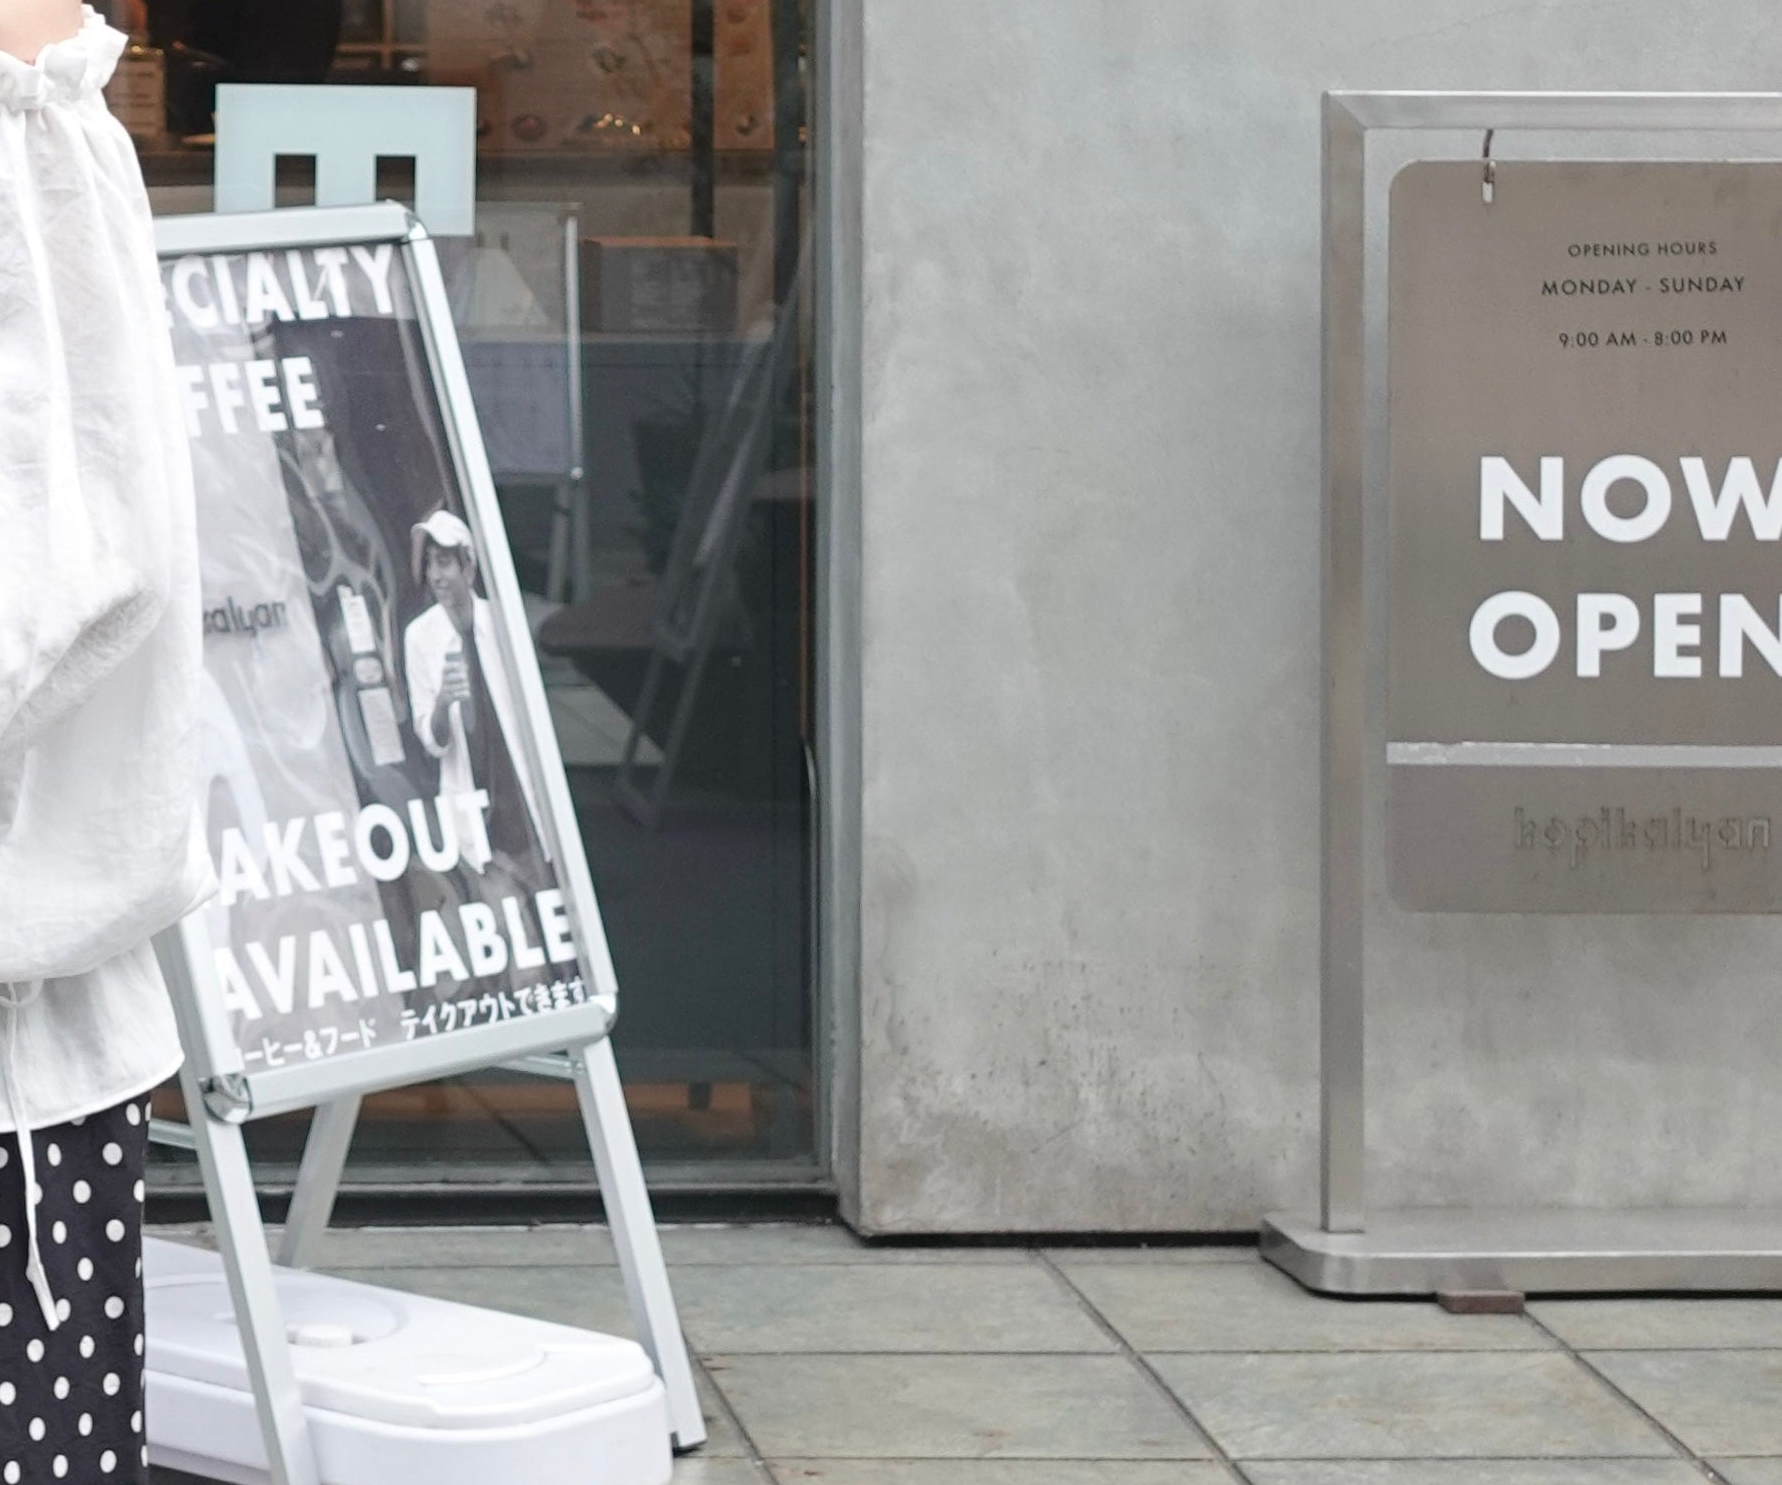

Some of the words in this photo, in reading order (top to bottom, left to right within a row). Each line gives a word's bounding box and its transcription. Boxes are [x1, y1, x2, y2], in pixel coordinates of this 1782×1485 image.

[1568, 243, 1650, 258] OPENING
[1657, 241, 1718, 256] HOURS
[1541, 279, 1638, 296] MONDAY
[1659, 276, 1745, 294] SUNDAY
[1559, 332, 1599, 347] 9:00
[1606, 332, 1637, 346] AM
[1654, 330, 1693, 346] 8:00
[1700, 329, 1728, 344] PM
[1480, 454, 1782, 543] NOW
[1469, 590, 1782, 680] OPEN
[213, 887, 578, 1021] AVAILABLE
